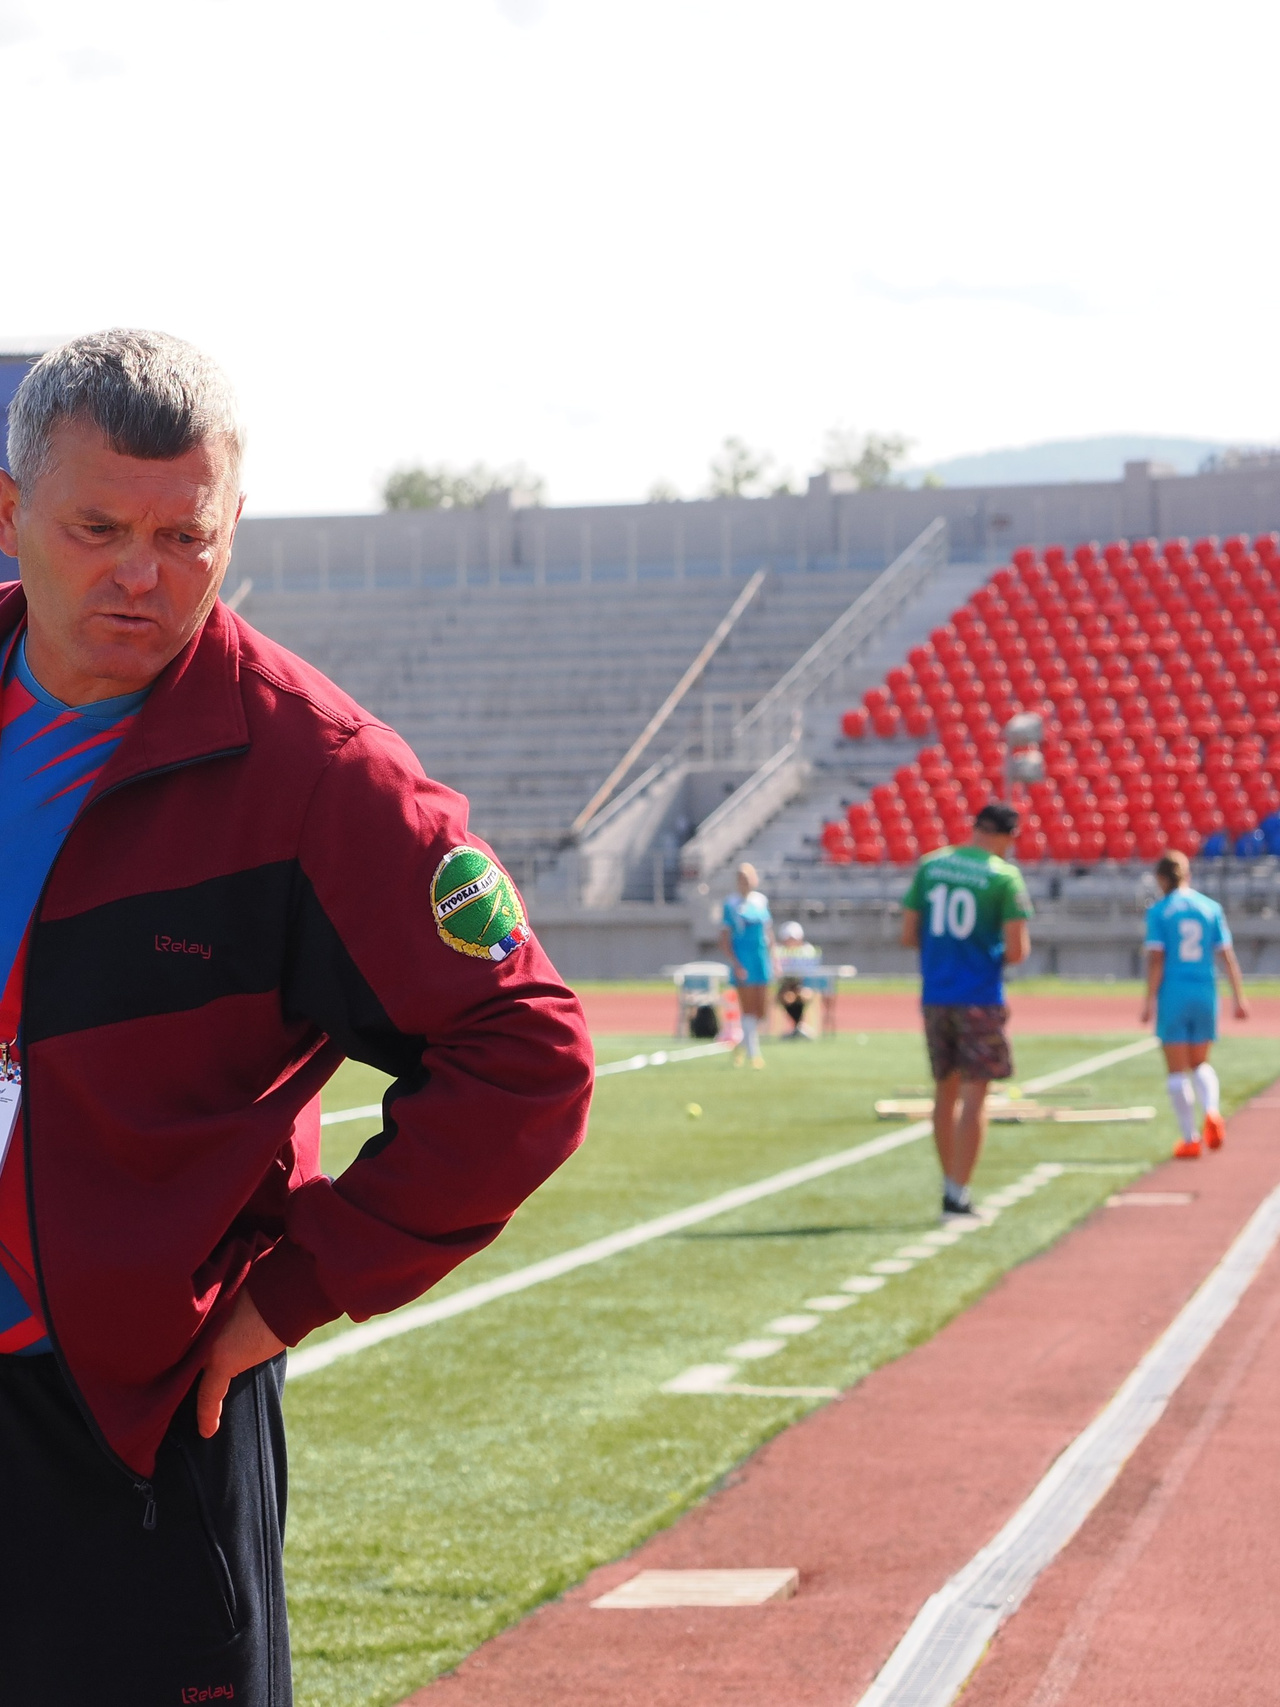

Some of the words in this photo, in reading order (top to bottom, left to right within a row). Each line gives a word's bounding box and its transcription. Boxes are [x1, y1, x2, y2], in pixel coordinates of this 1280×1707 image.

[927, 883, 976, 940] 10
[154, 934, 212, 960] Relay
[1179, 919, 1203, 962] 2
[181, 1682, 234, 1705] Relay
